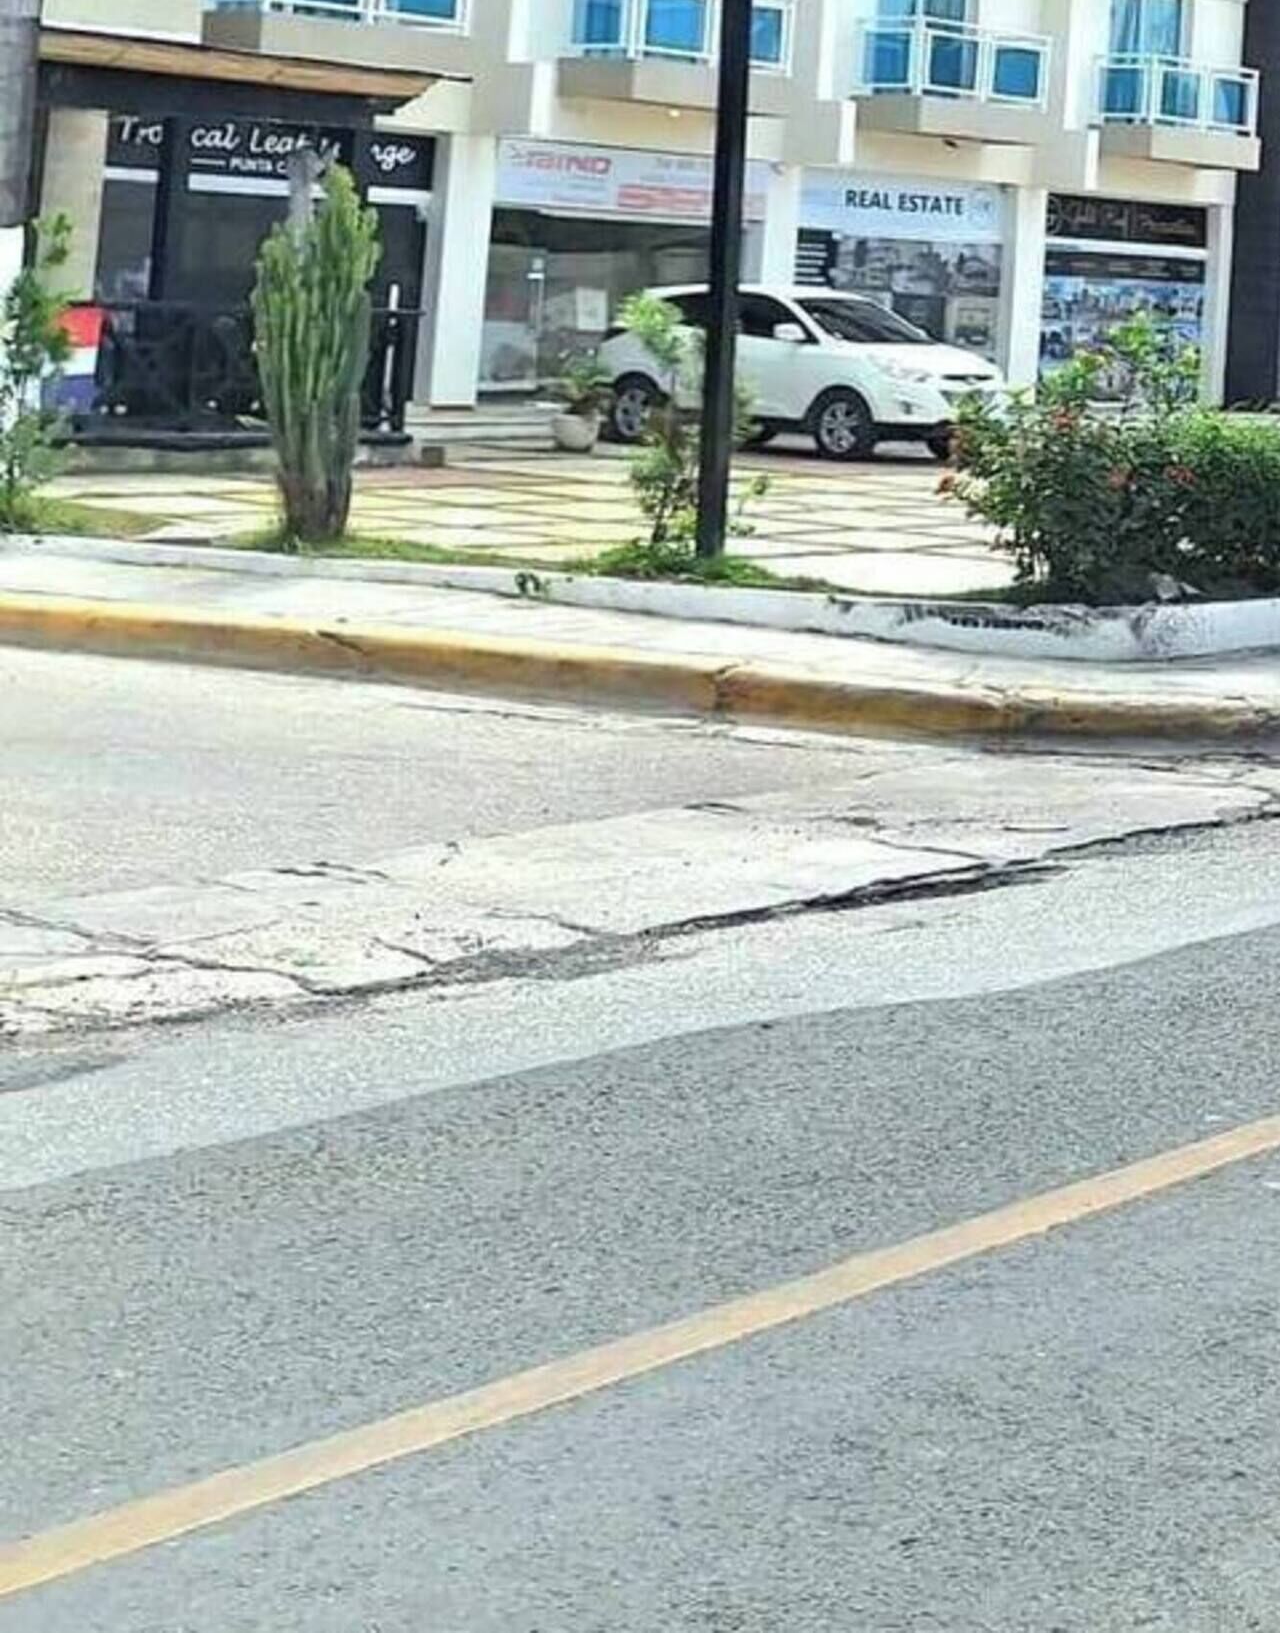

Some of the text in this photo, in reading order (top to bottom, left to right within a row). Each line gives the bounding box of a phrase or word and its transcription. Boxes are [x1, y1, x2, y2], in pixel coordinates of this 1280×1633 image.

[116, 115, 241, 151] Trocal
[845, 189, 965, 216] REAL ESTATE
